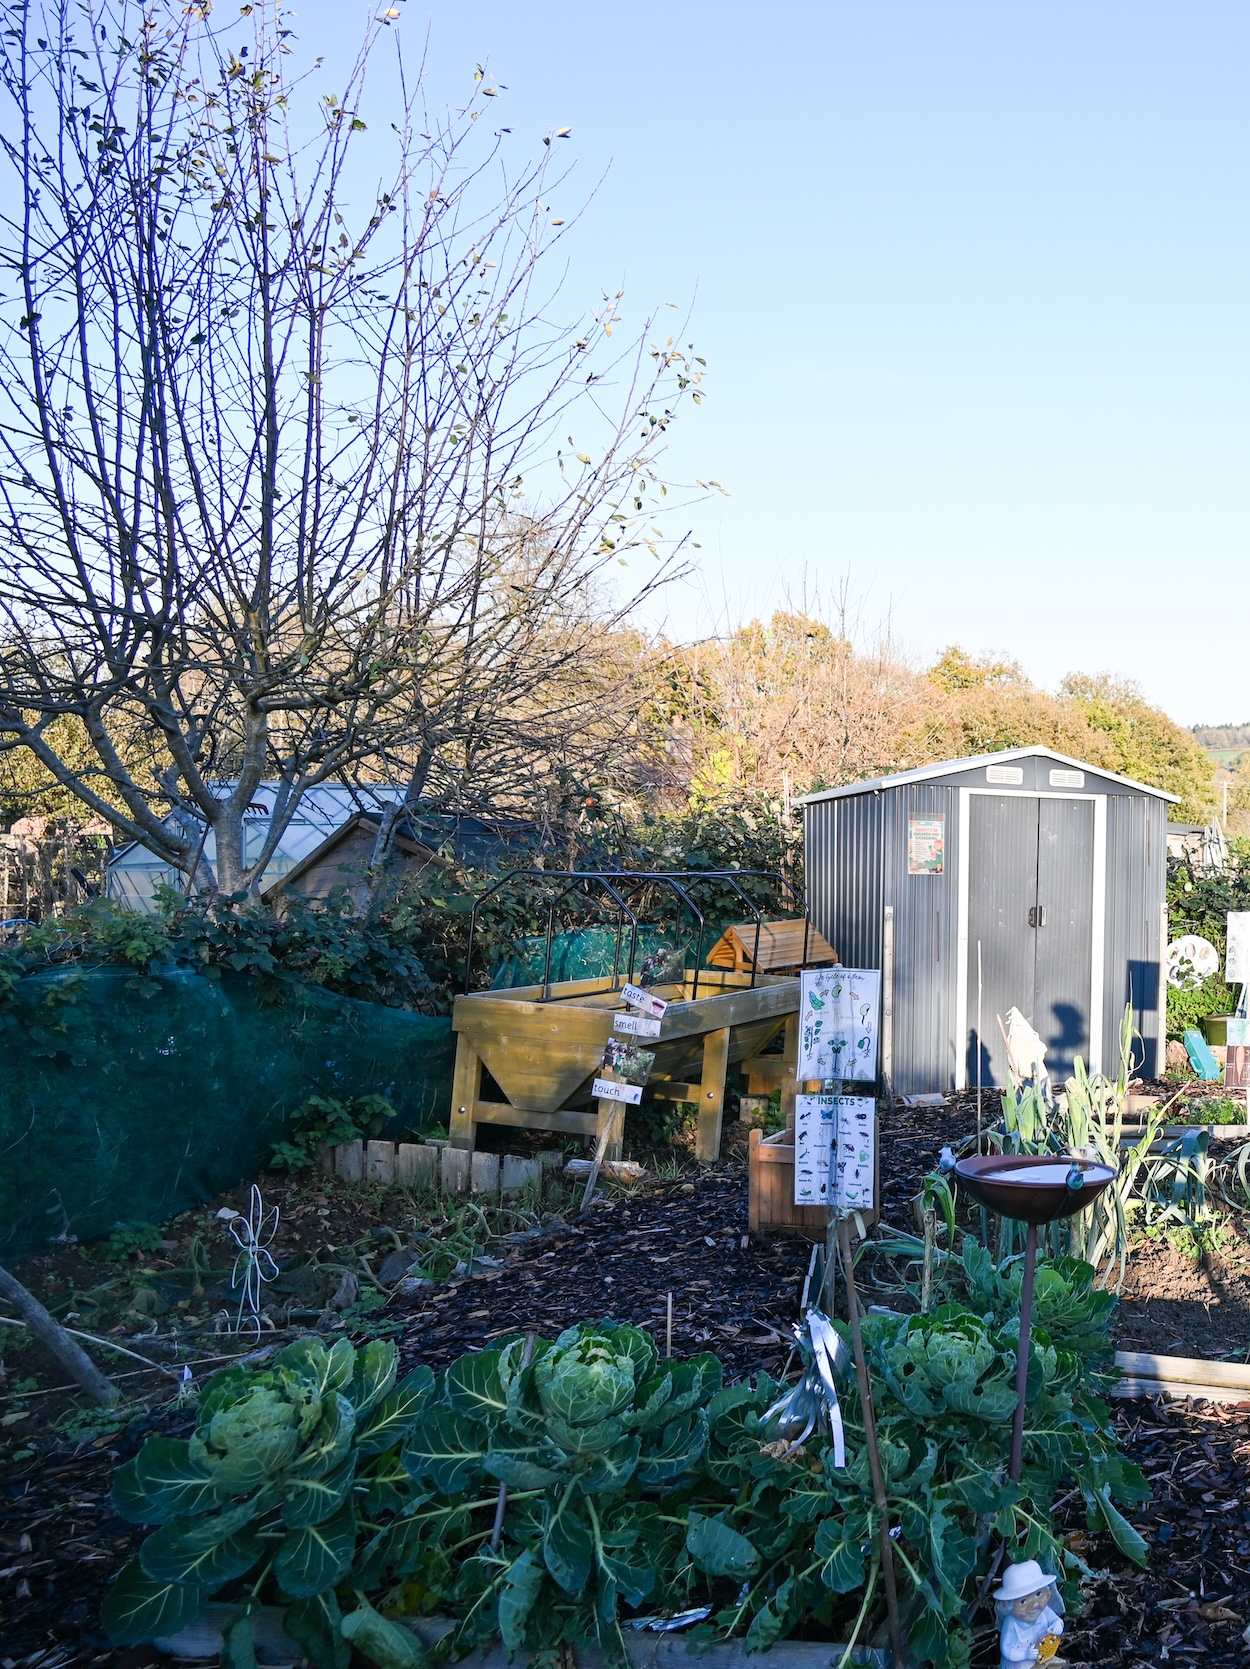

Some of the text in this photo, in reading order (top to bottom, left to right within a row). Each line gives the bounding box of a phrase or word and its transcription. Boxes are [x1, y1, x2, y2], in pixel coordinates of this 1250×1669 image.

[623, 987, 645, 1003] taste
[614, 1020, 638, 1031] smell
[593, 1084, 620, 1097] touch
[817, 1096, 855, 1106] INSECTS
